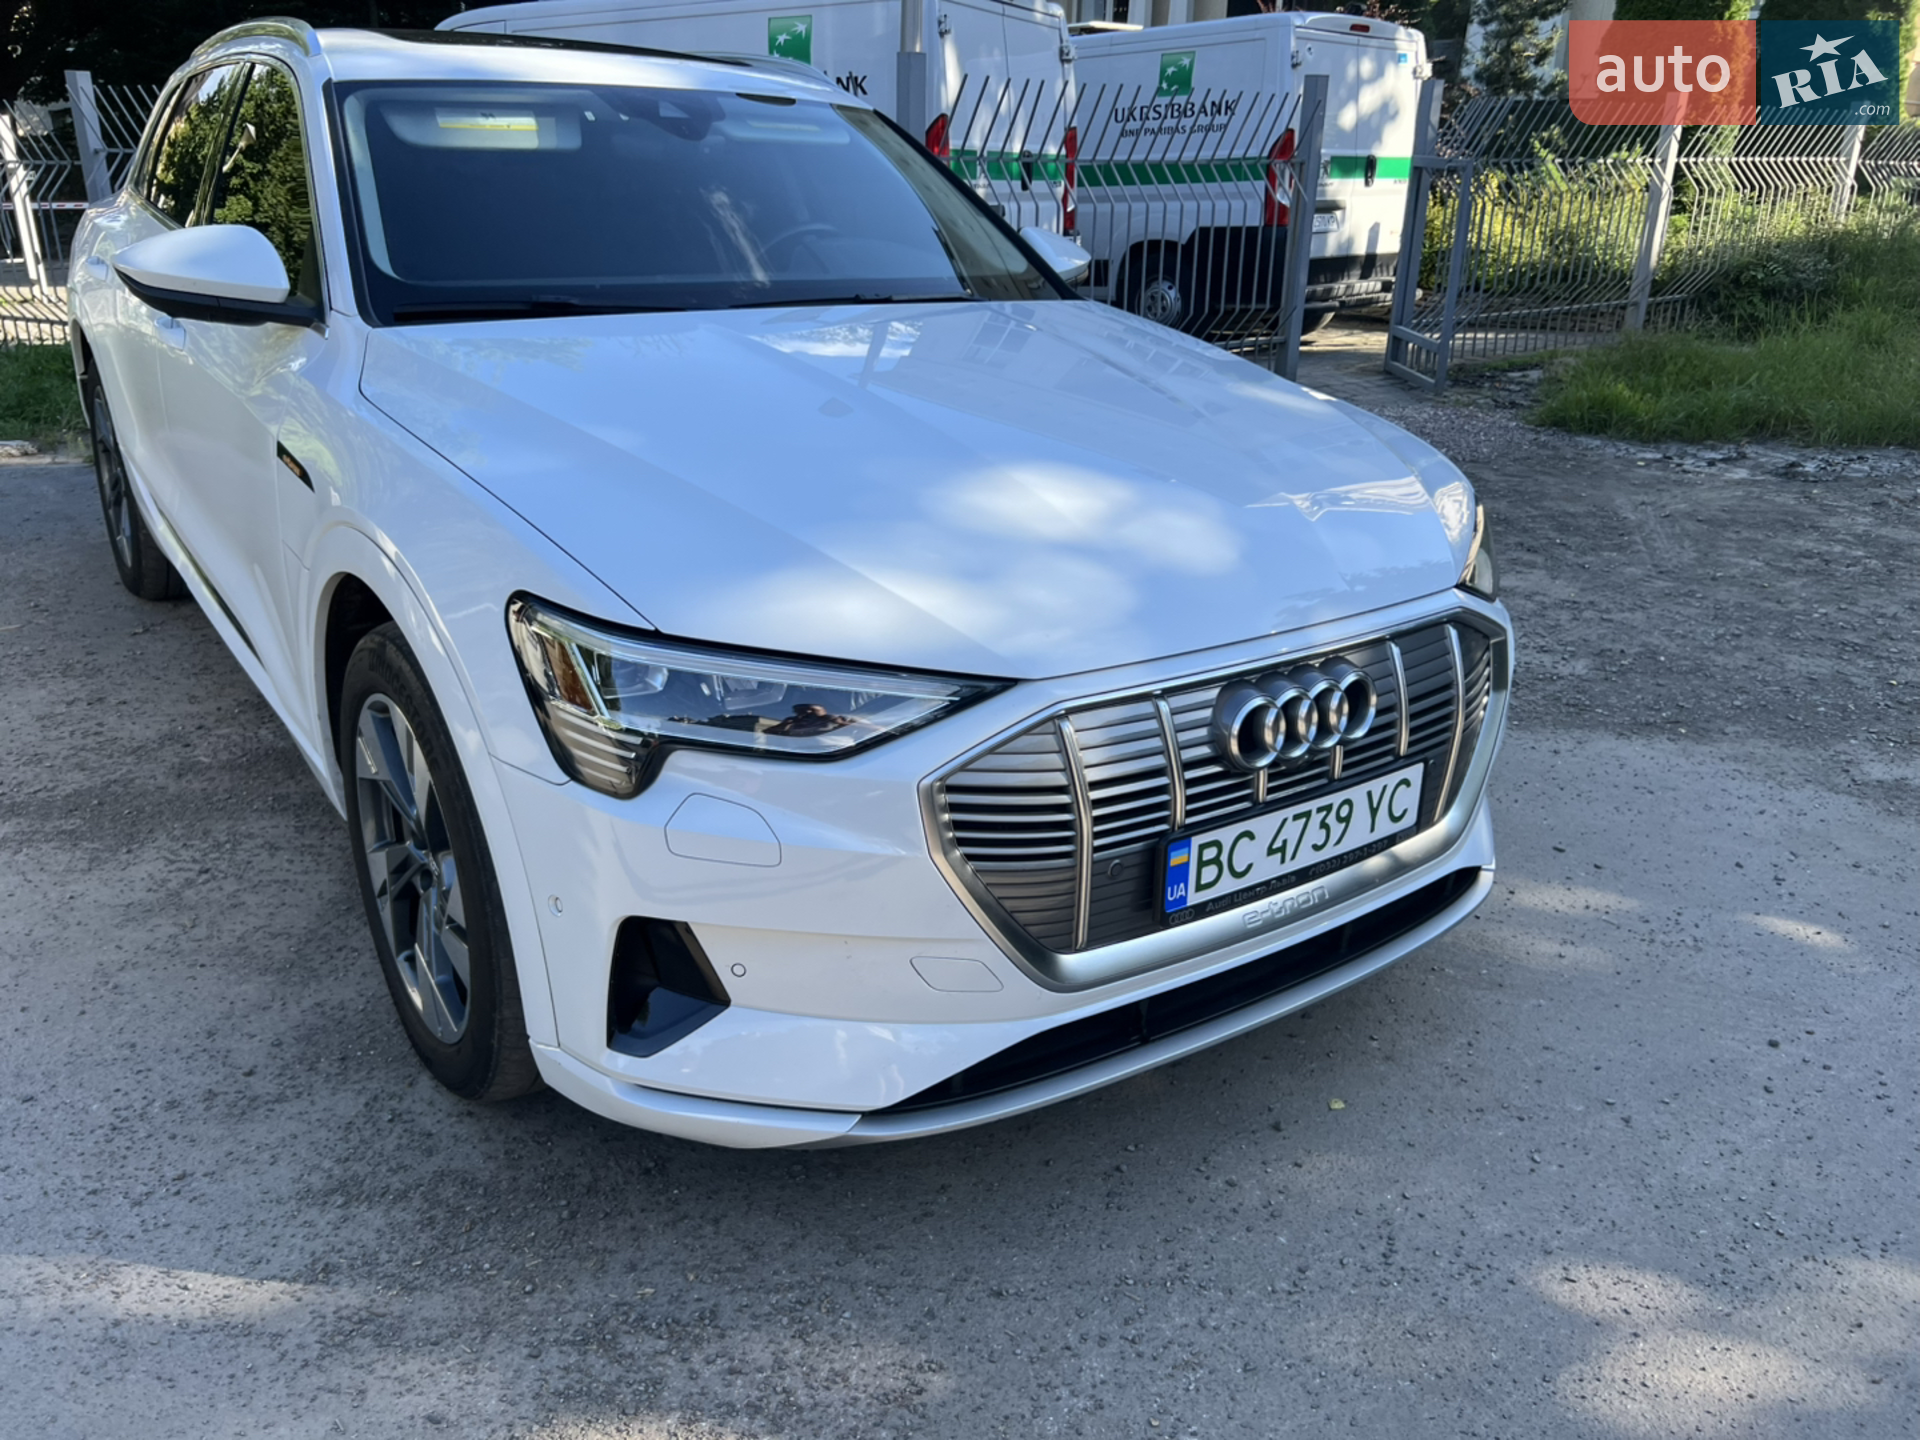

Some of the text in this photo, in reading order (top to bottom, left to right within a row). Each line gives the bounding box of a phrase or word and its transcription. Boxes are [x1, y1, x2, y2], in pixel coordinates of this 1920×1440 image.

[1114, 99, 1237, 124] UKRSIBBANK
[1143, 125, 1187, 137] PARIBAS
[1194, 777, 1412, 893] BC 4739 YC
[1167, 882, 1186, 901] UA
[1205, 895, 1232, 912] Audi
[1233, 884, 1266, 903] Центр
[1243, 885, 1330, 928] e-tron
